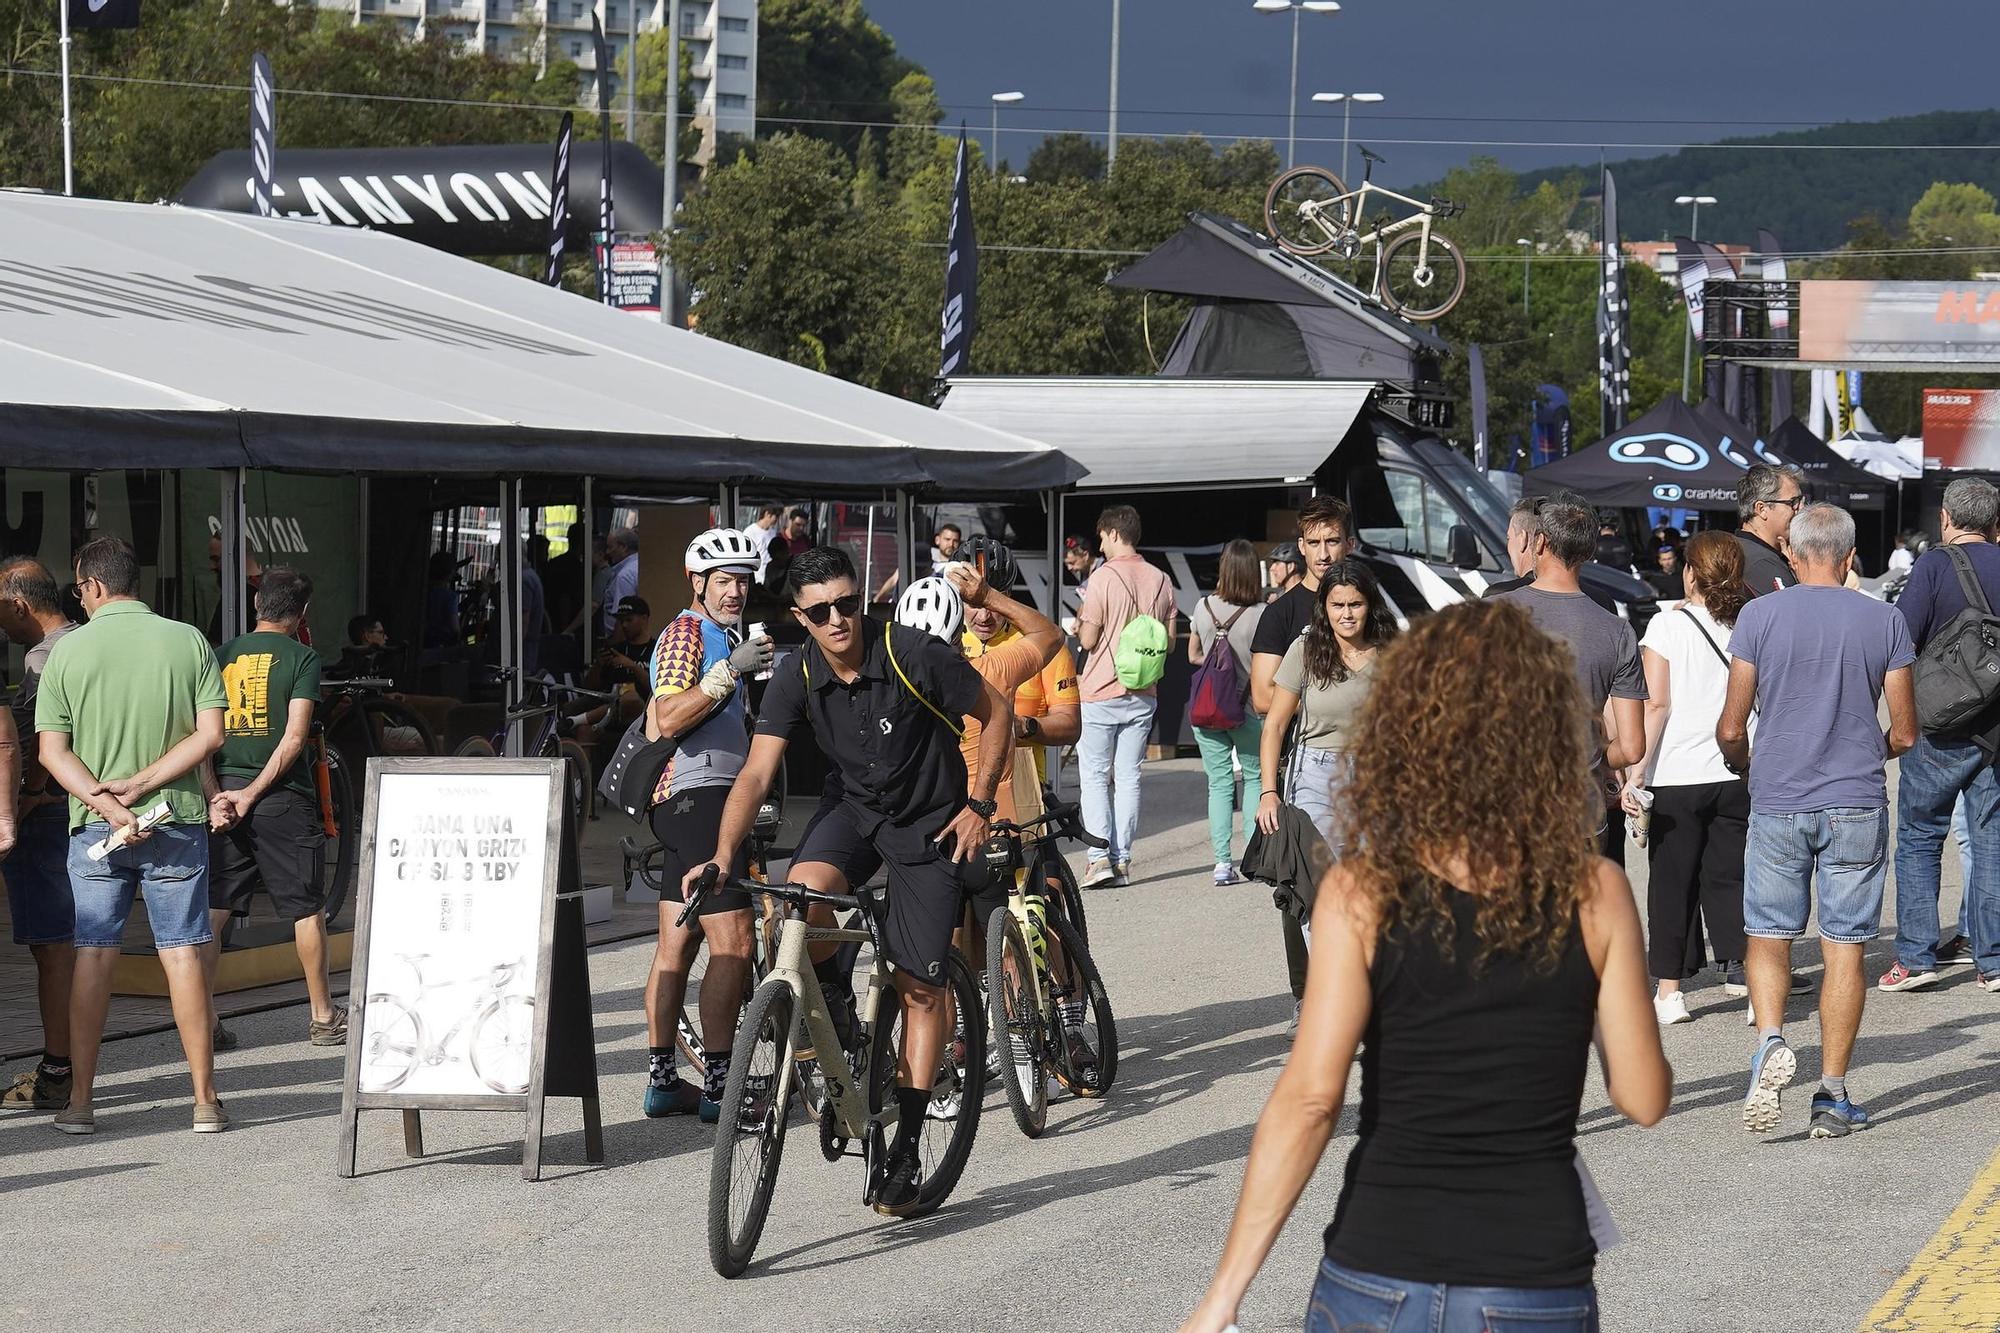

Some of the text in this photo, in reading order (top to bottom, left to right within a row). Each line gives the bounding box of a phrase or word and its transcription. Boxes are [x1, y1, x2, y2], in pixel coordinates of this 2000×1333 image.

[625, 295, 650, 305] EUROPA
[1926, 394, 1972, 404] MAXXIS
[207, 515, 309, 553] CNYON
[473, 814, 513, 834] UNA
[482, 861, 521, 881] 1BY
